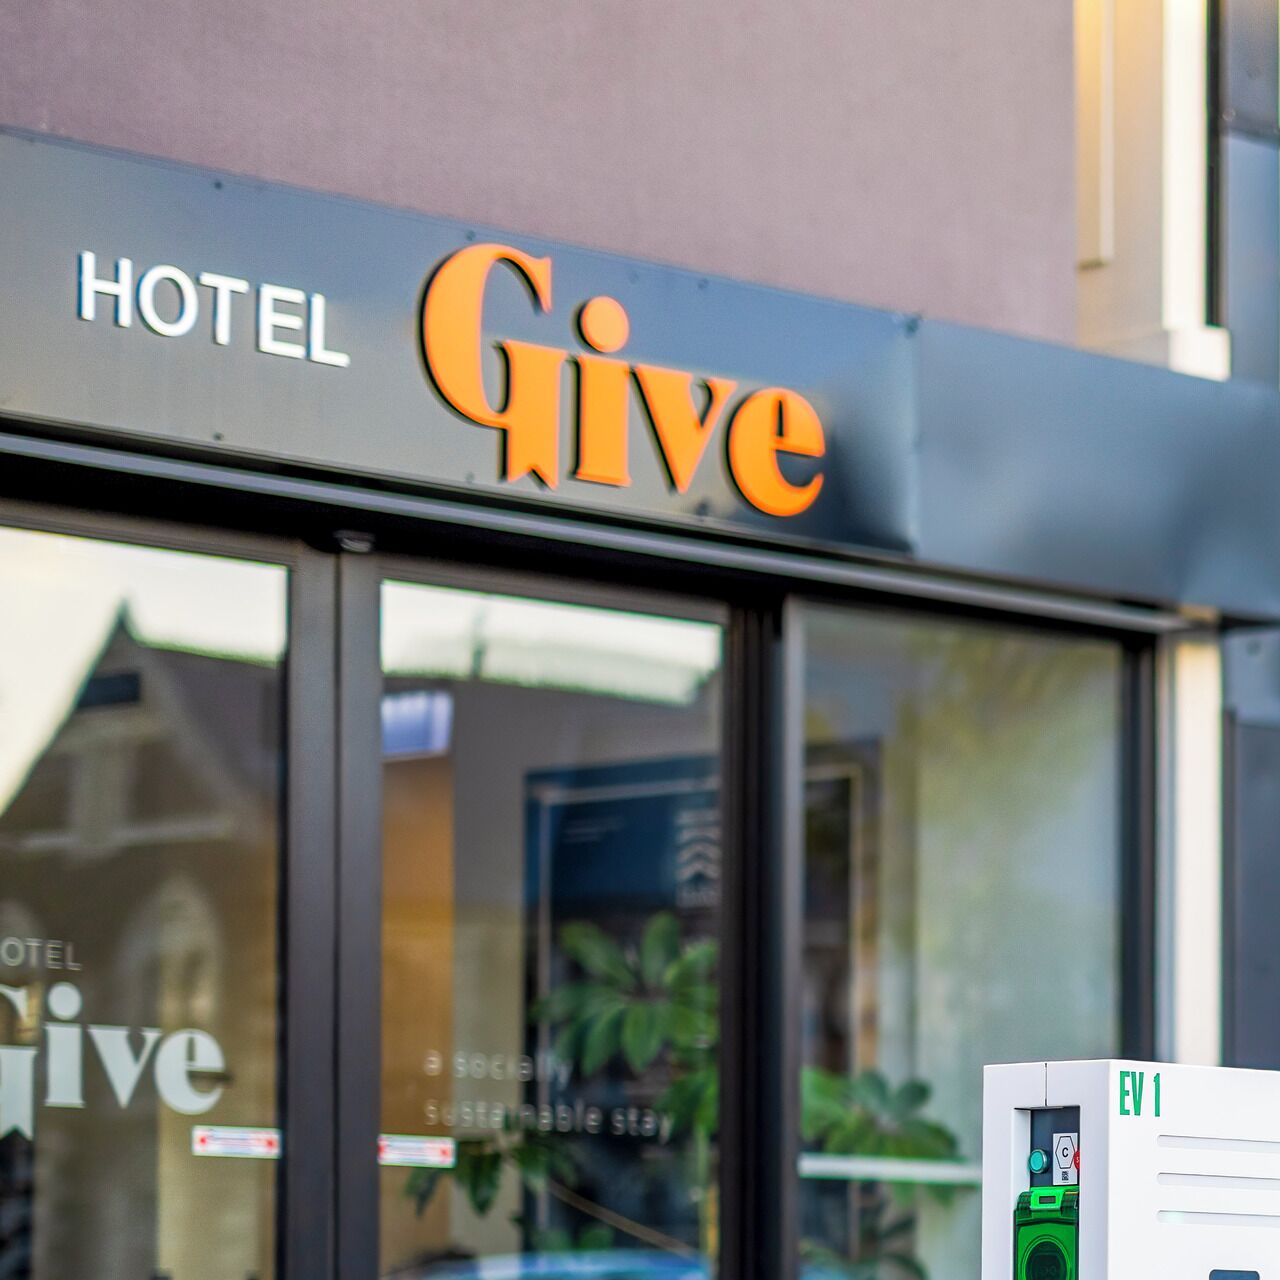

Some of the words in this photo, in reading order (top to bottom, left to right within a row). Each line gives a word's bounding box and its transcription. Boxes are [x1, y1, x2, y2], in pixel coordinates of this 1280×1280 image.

[77, 249, 351, 368] HOTEL
[421, 243, 826, 518] Give
[1119, 1071, 1145, 1117] EV
[1153, 1073, 1161, 1118] 1
[1061, 1147, 1069, 1158] C
